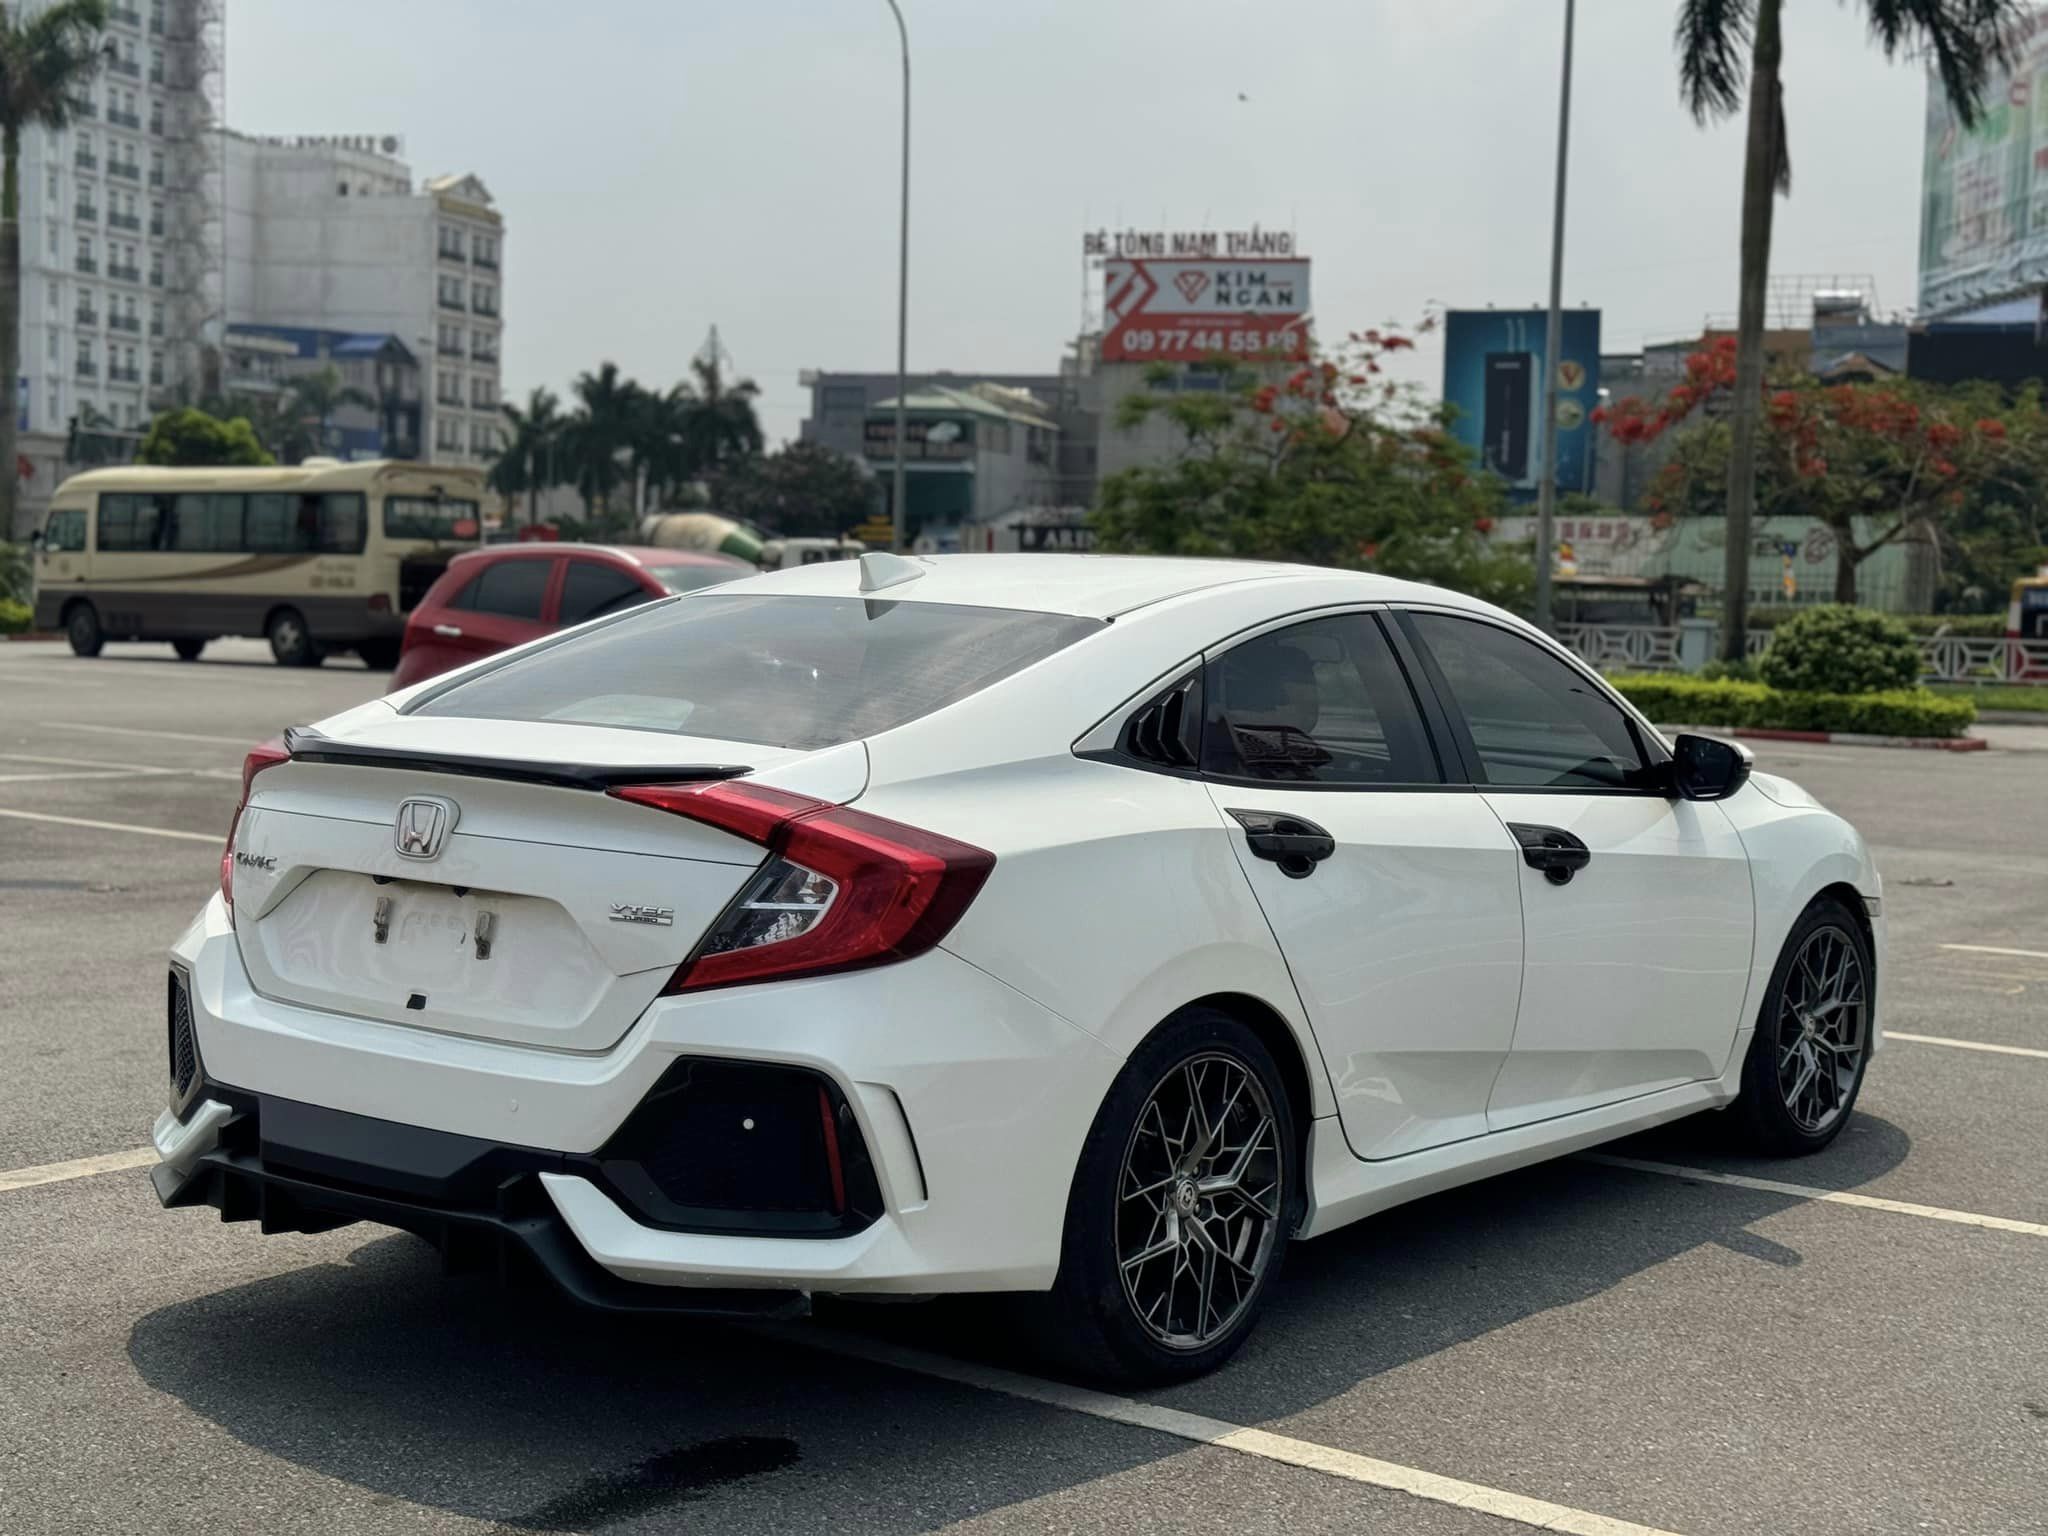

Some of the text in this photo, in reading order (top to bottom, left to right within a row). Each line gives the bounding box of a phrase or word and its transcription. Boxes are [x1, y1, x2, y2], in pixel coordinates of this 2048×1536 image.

[1173, 232, 1217, 253] NAM
[1216, 271, 1266, 286] KIM
[610, 903, 674, 916] VTEC
